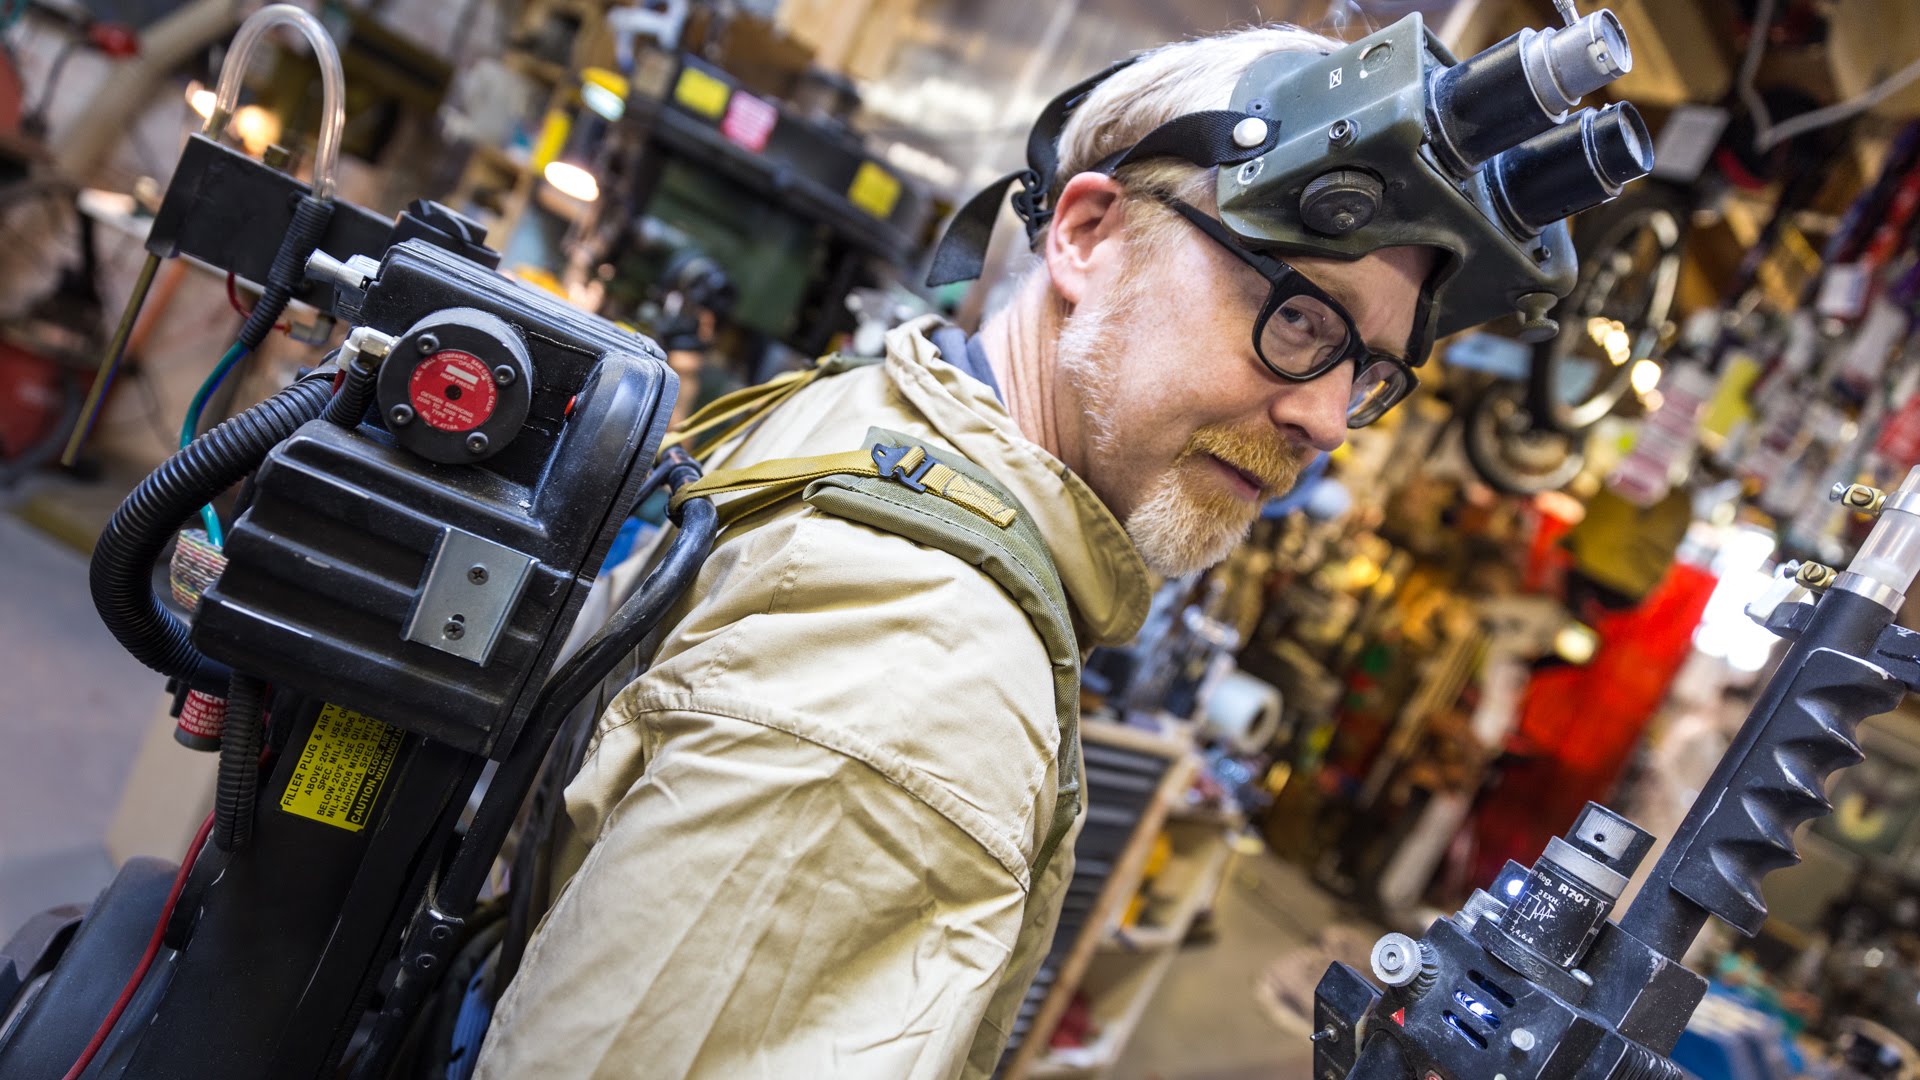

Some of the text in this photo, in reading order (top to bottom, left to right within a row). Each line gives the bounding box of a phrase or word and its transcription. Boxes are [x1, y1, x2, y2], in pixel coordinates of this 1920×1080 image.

[458, 360, 474, 370] OPEN
[420, 390, 474, 418] OXYGEN SERVICING
[431, 408, 446, 418] TYPE
[432, 402, 441, 410] TO
[330, 721, 343, 739] USE
[342, 742, 355, 760] USE
[351, 726, 362, 741] OIL
[348, 743, 365, 769] MIXED
[362, 718, 376, 741] WITH
[284, 774, 305, 806] FILLER
[300, 744, 318, 770] PLUG
[318, 714, 330, 730] AIR
[318, 717, 356, 791] SPEC. MIL-H-5606
[368, 746, 385, 776] CLOSE
[381, 732, 391, 747] AIR
[375, 755, 390, 781] WHEN
[389, 737, 399, 756] NOT
[339, 772, 363, 813] NAPHTHA
[360, 745, 375, 768] SPEC
[351, 777, 376, 823] CAUTION
[1537, 871, 1552, 886] Reg.
[1558, 883, 1591, 907] R701
